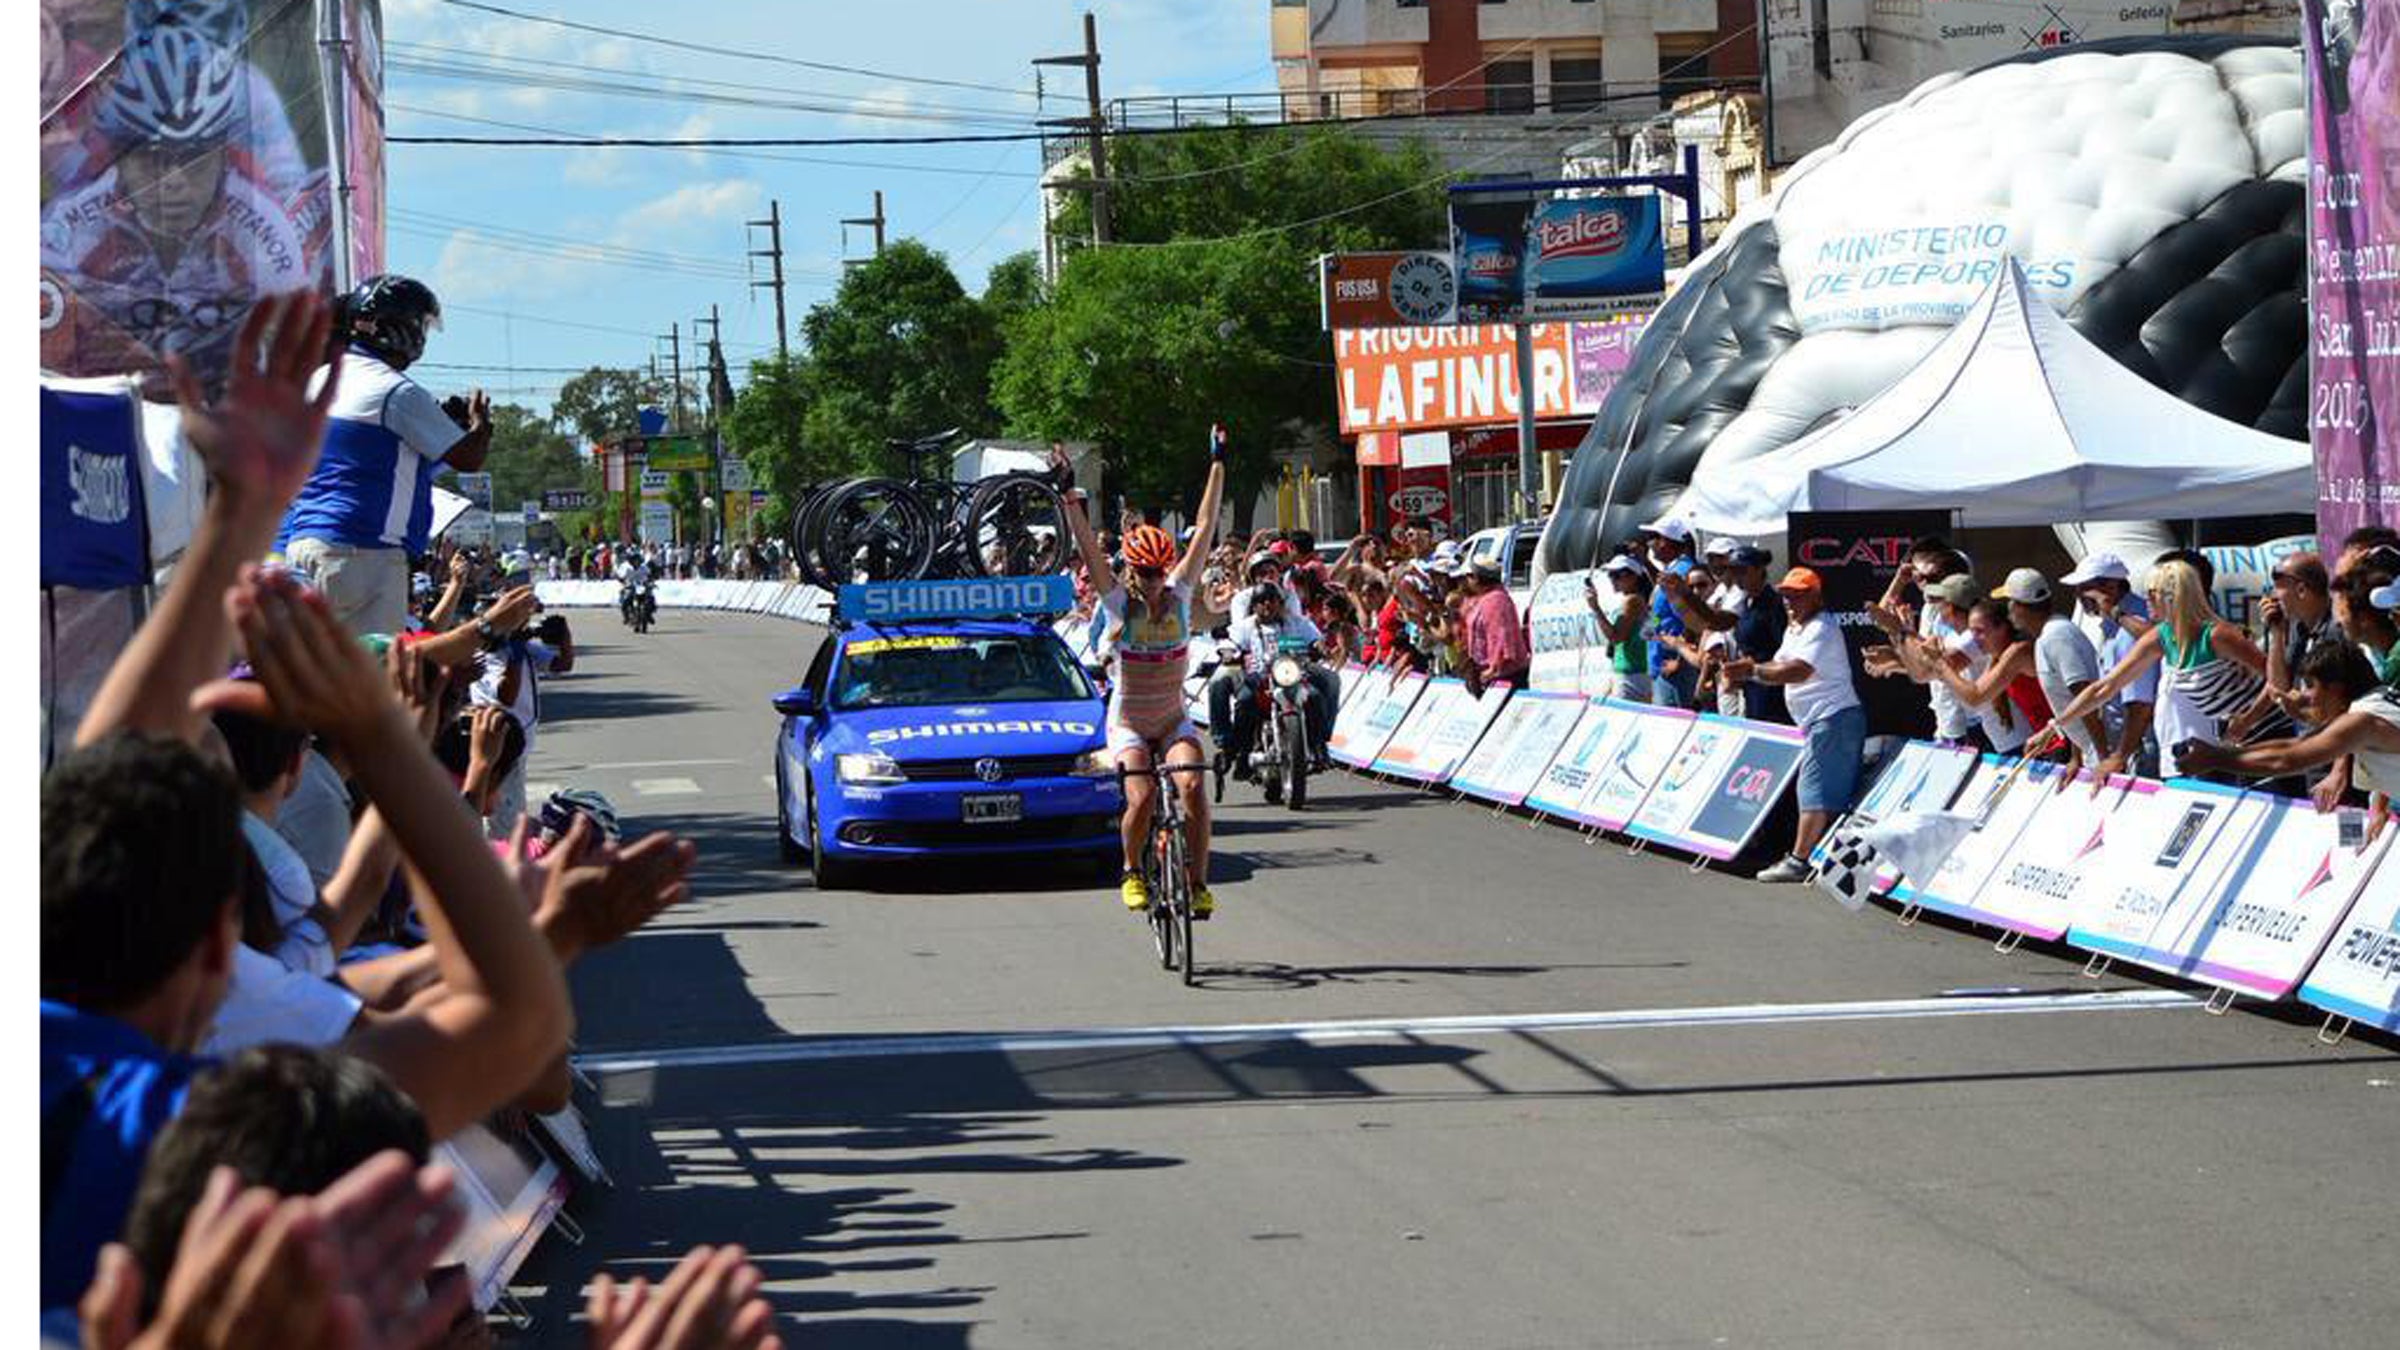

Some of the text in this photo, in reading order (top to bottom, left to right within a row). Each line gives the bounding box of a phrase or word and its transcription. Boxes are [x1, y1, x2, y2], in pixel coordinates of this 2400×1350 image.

[1940, 24, 2006, 39] Sanitarios
[1538, 210, 1621, 249] talca
[1817, 223, 2007, 263] MINISTERIO
[1803, 258, 2076, 300] DE DEPORES
[1343, 347, 1564, 427] LAFINUR
[1798, 537, 1915, 567] CAT
[864, 581, 1048, 614] SHIMANO
[866, 717, 1096, 746] SHIMANO
